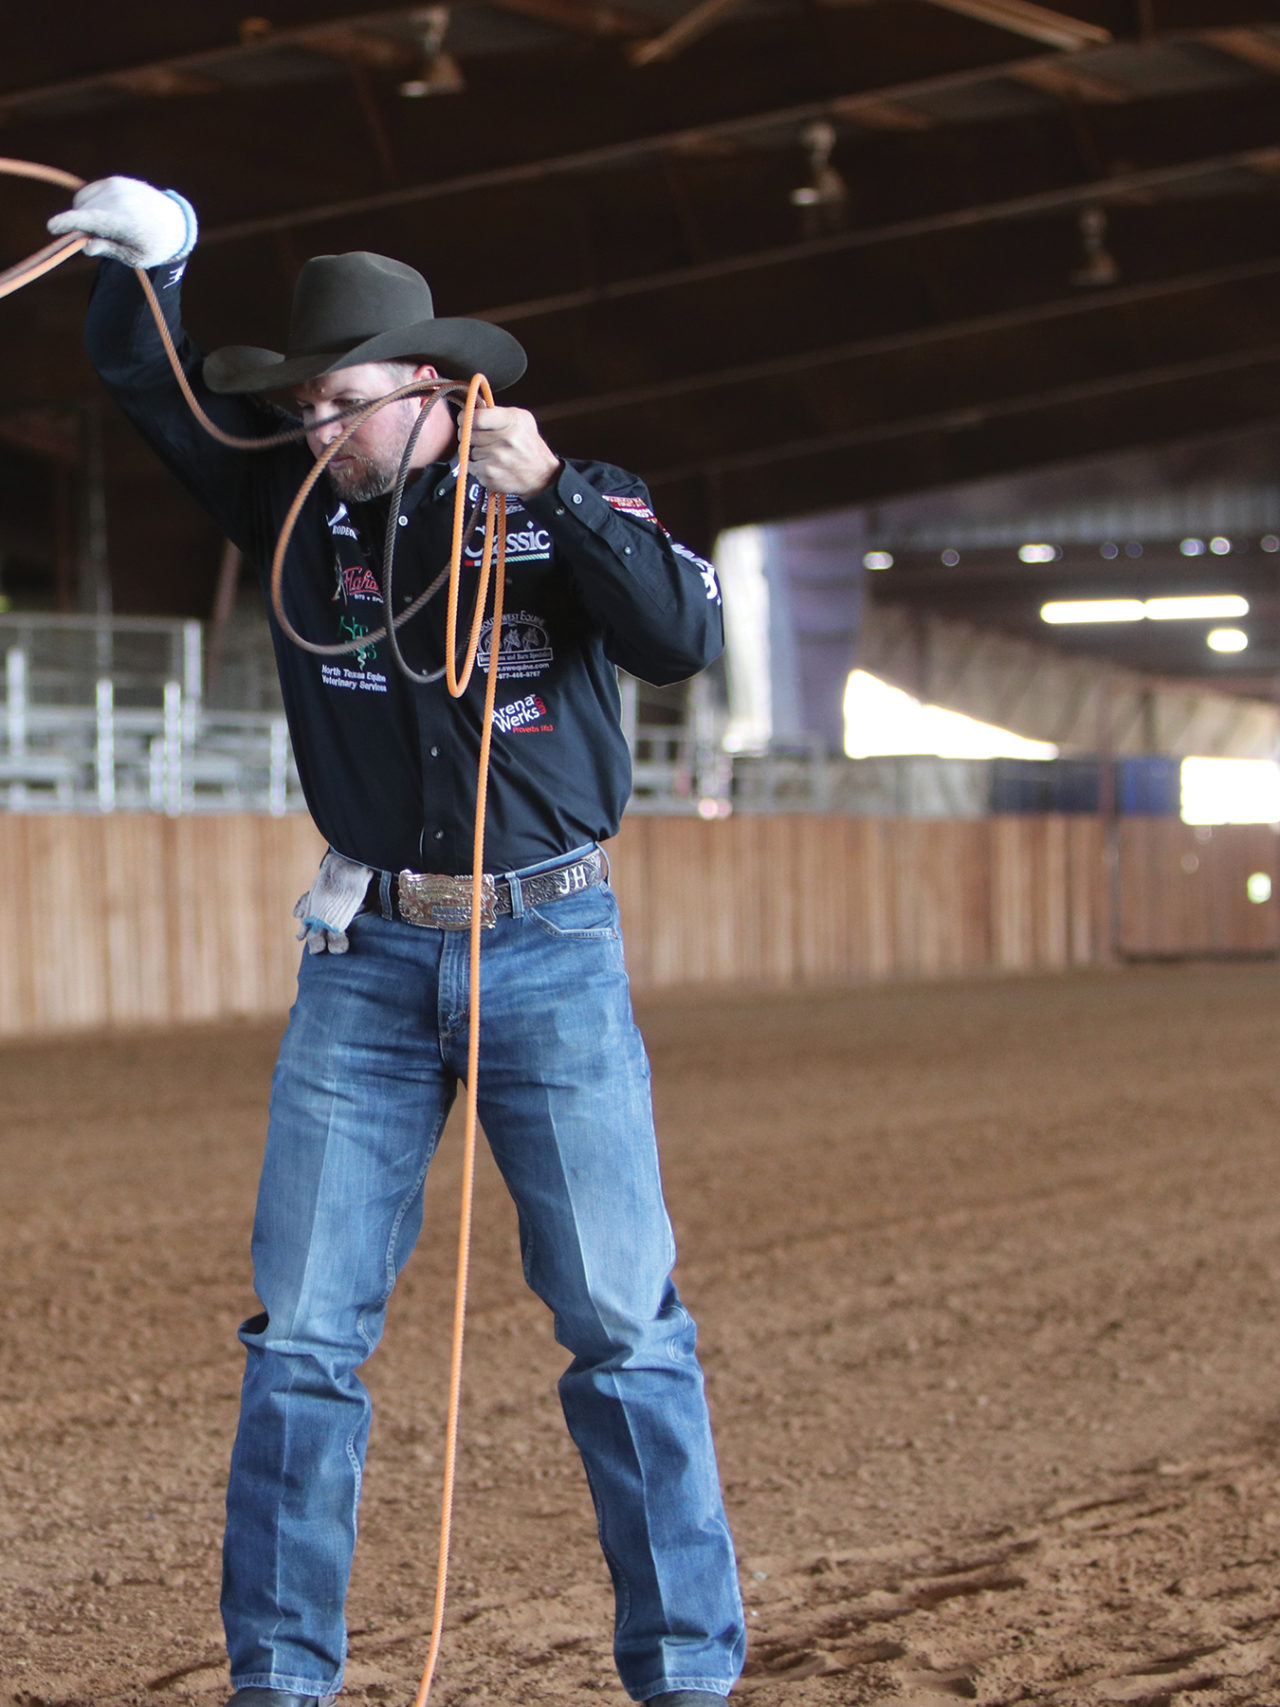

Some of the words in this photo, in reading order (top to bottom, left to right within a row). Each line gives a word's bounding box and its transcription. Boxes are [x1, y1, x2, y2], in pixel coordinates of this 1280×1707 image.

[322, 664, 341, 677] North
[322, 675, 357, 690] Veterinary
[491, 696, 535, 722] Arena
[495, 702, 540, 733] Werks
